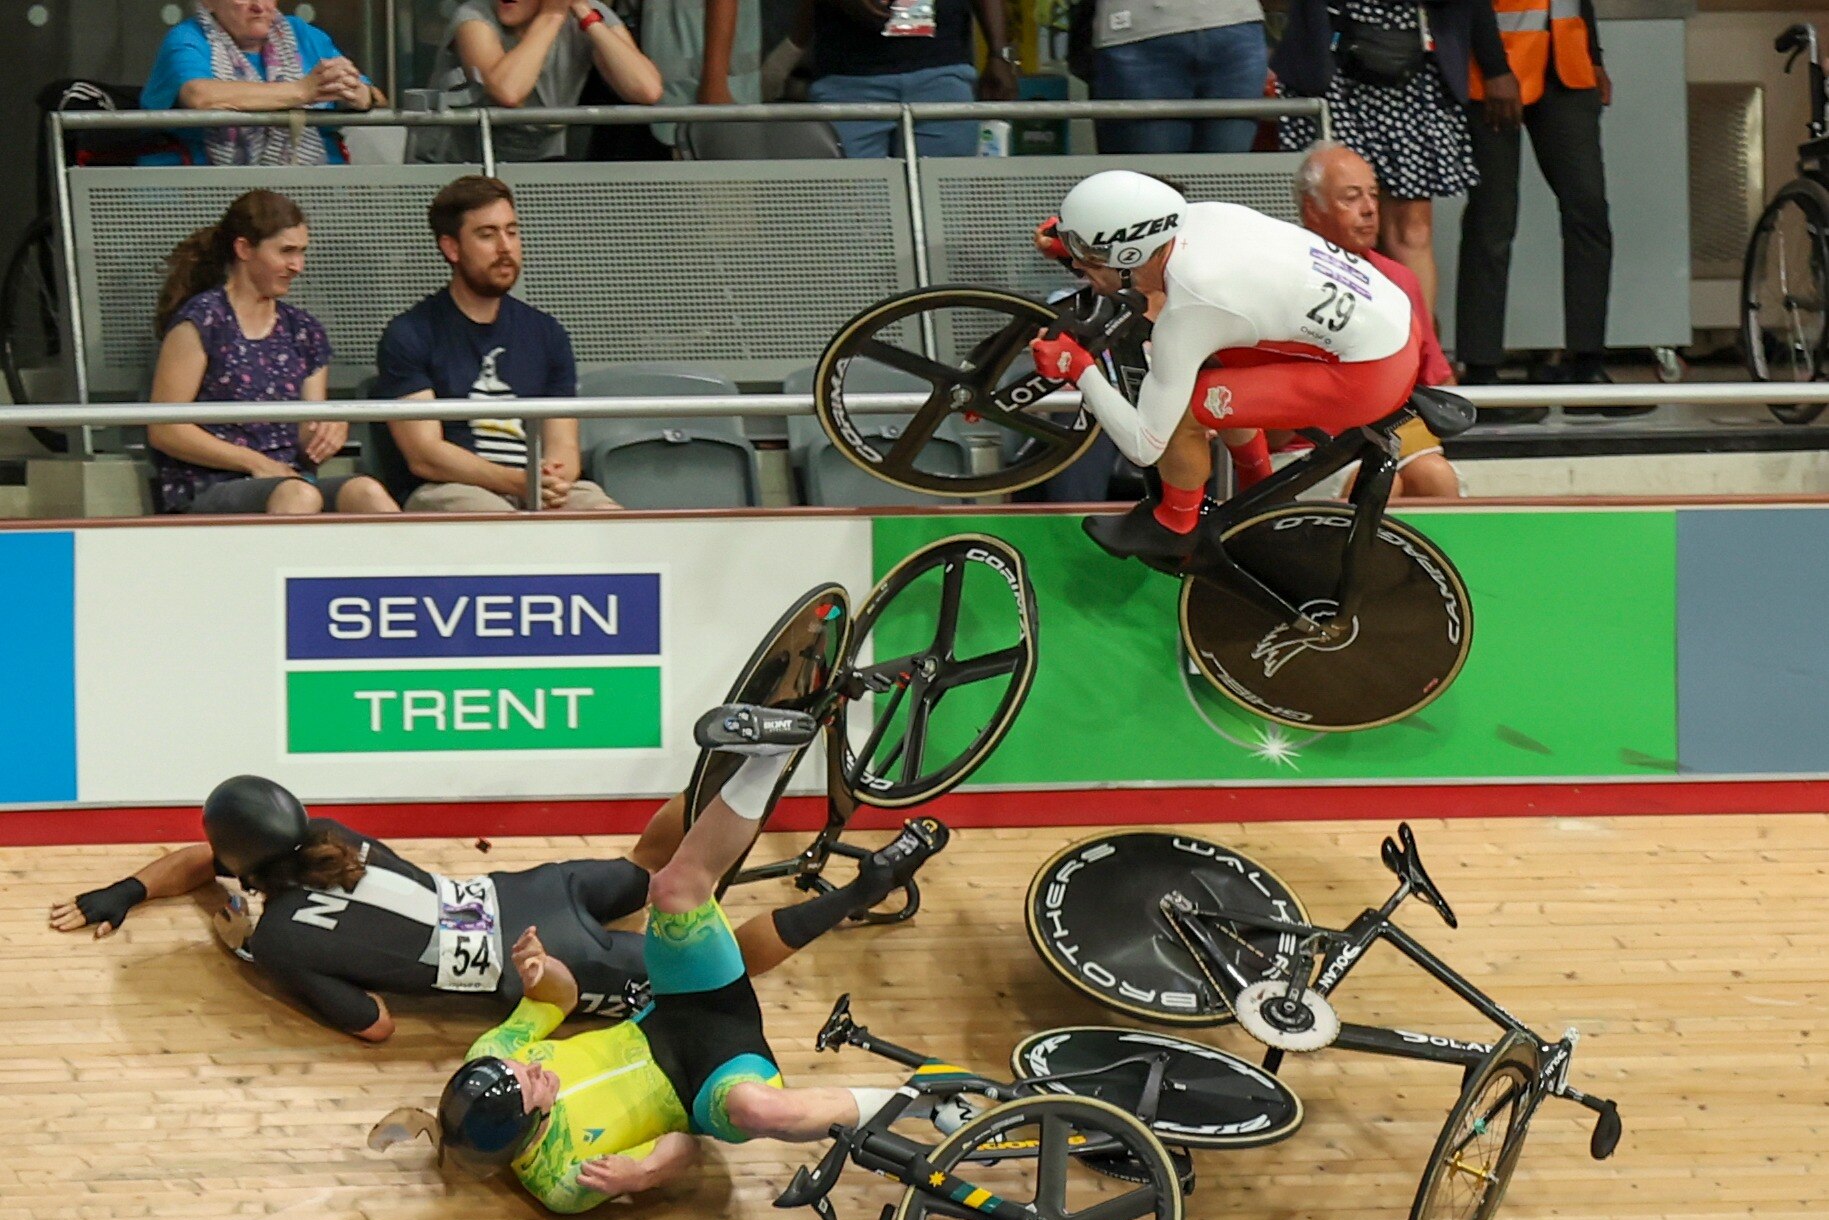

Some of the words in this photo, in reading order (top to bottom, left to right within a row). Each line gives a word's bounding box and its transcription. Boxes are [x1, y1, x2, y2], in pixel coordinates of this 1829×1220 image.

[1091, 213, 1179, 246] LAZER
[1307, 281, 1356, 332] 29
[994, 377, 1066, 413] LOT
[1274, 515, 1461, 645] CAMPAGOLO
[328, 594, 618, 639] SEVERN
[354, 688, 594, 731] TRENT
[291, 892, 349, 931] N
[452, 935, 491, 977] 54
